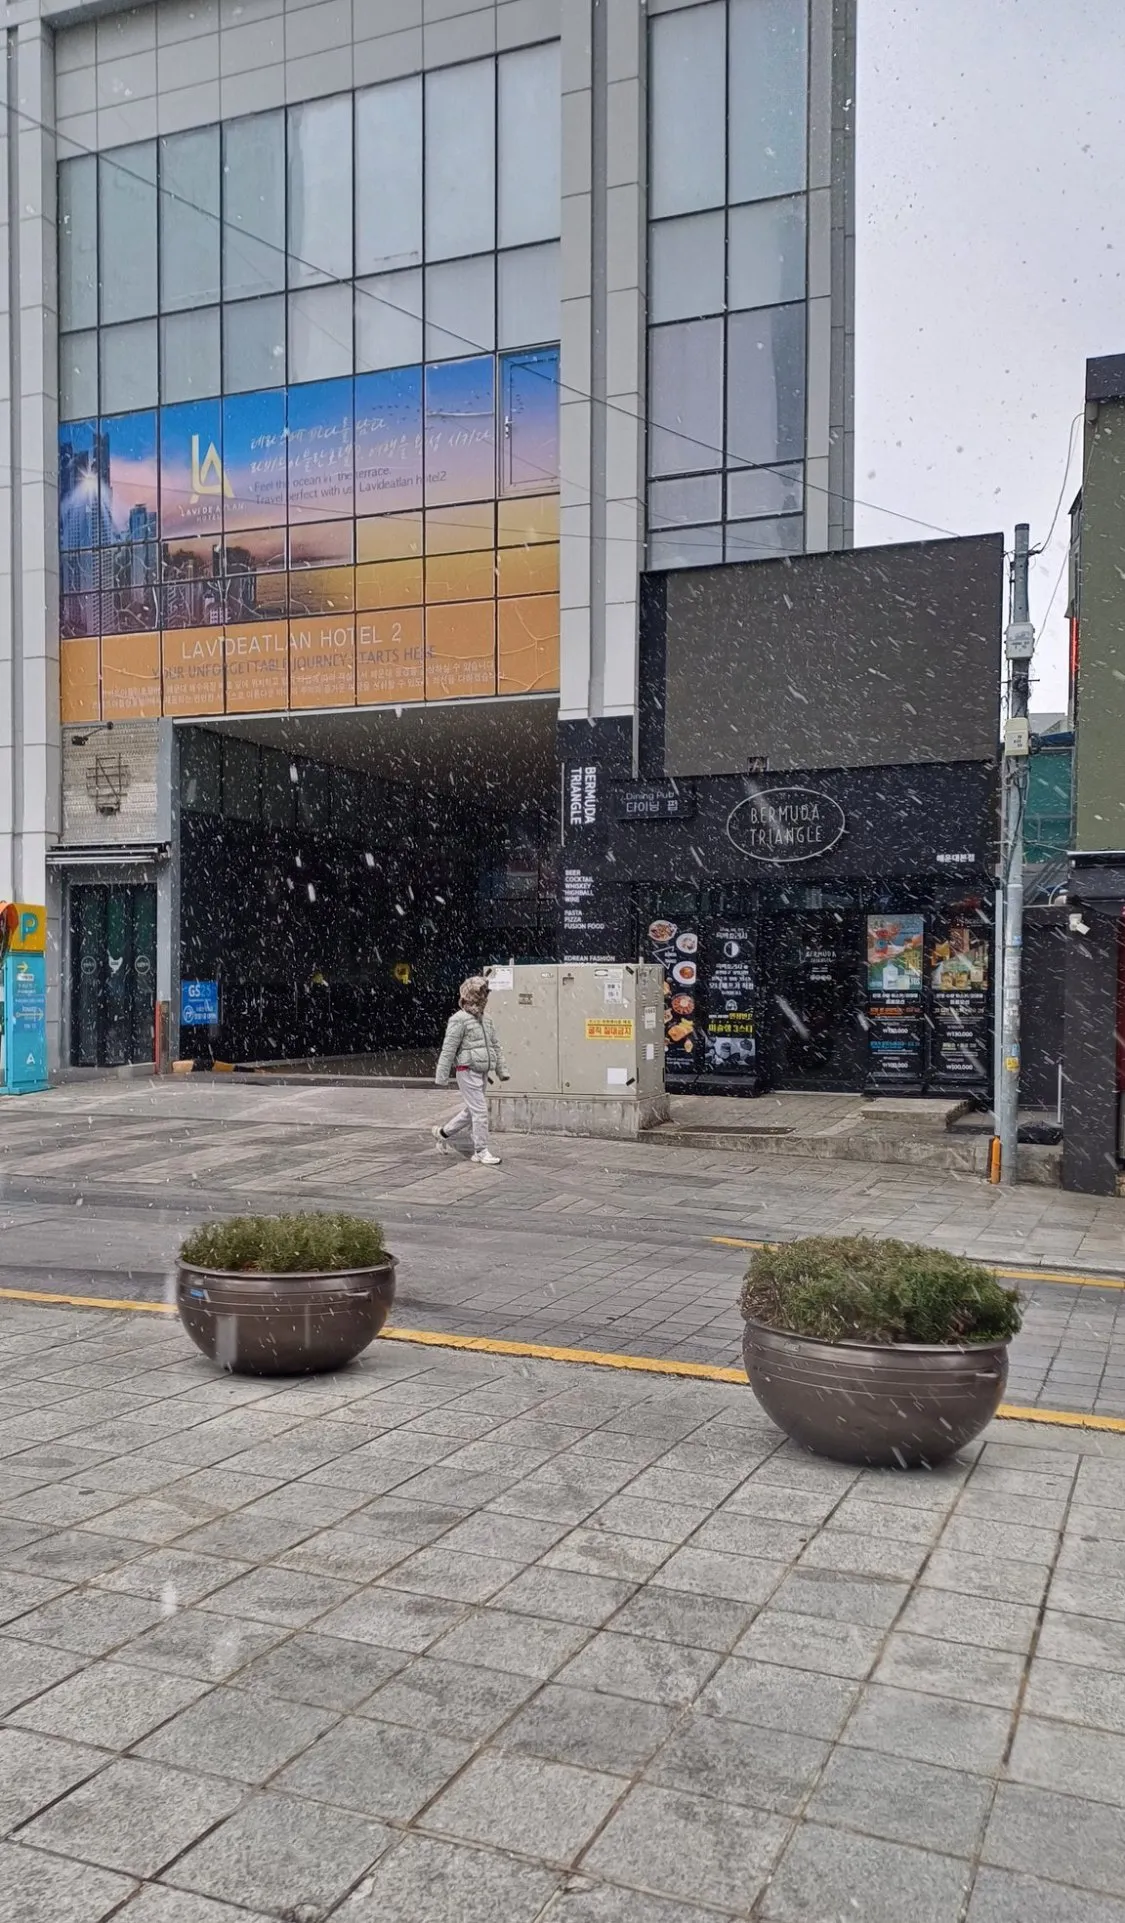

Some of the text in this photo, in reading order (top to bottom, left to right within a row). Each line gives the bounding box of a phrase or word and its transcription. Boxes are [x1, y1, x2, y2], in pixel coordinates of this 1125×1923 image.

[254, 480, 273, 492] Feel
[293, 475, 322, 487] ocean
[337, 470, 353, 482] the
[256, 491, 283, 505] Travel
[287, 487, 318, 502] erfect
[320, 484, 341, 497] with
[359, 475, 413, 493] Lavideatlan
[182, 622, 402, 659] LAVIDEATLAN HOTEL 2
[570, 767, 582, 825] TRIANGLE
[585, 766, 597, 824] BERMUDA
[626, 791, 675, 802] Dining Pub
[626, 801, 660, 813] 다이닝
[750, 804, 821, 824] BERMUDA
[750, 826, 823, 846] TRIANGLE
[20, 912, 39, 942] P
[188, 984, 211, 998] GS25
